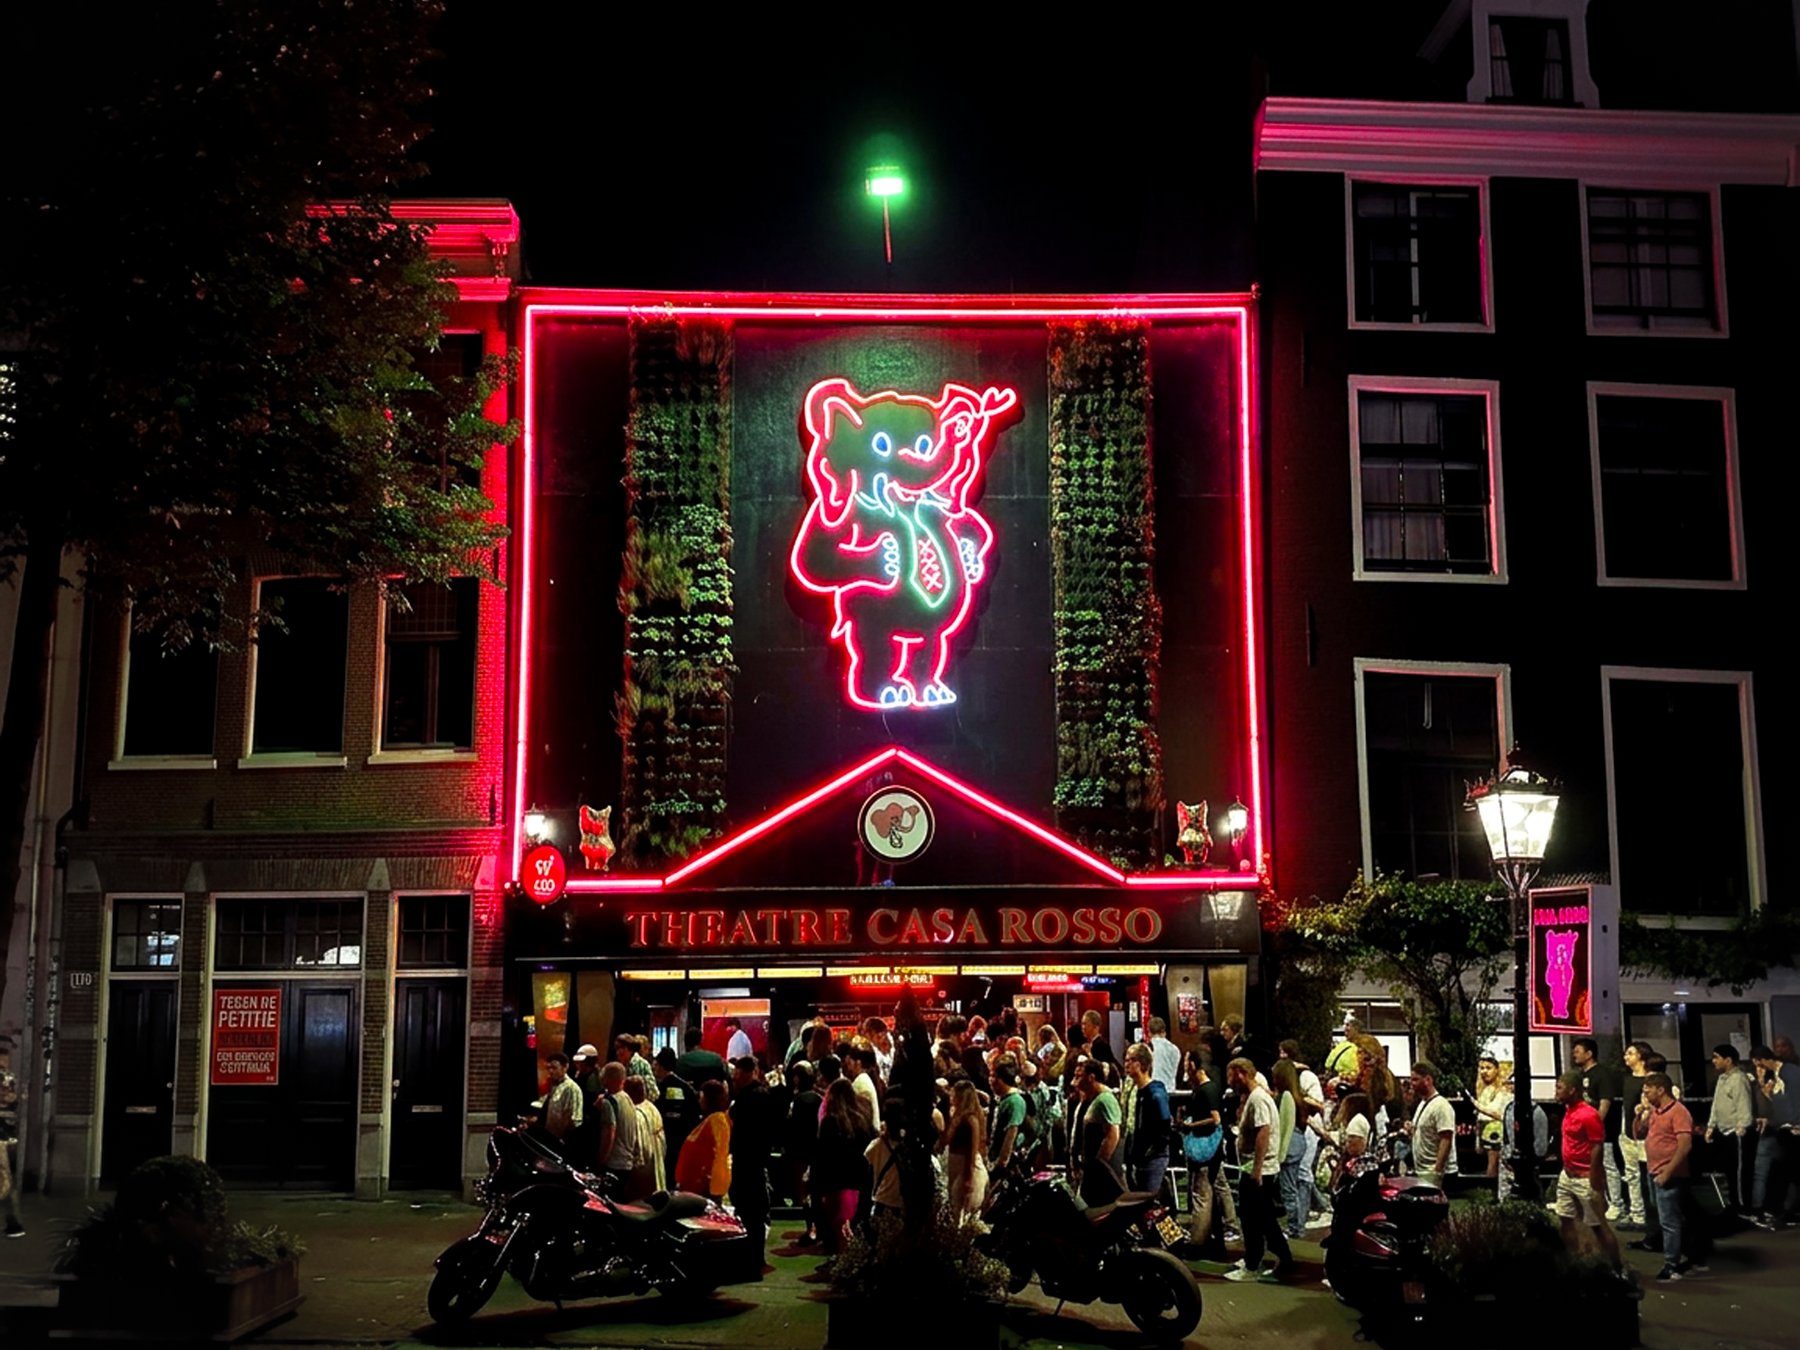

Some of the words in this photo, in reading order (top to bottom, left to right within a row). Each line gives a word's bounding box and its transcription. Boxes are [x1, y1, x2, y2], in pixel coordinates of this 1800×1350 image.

[624, 908, 853, 948] THEATRE
[866, 907, 988, 945] CASA
[998, 906, 1163, 944] ROSSO
[218, 1010, 277, 1028] PETITIE
